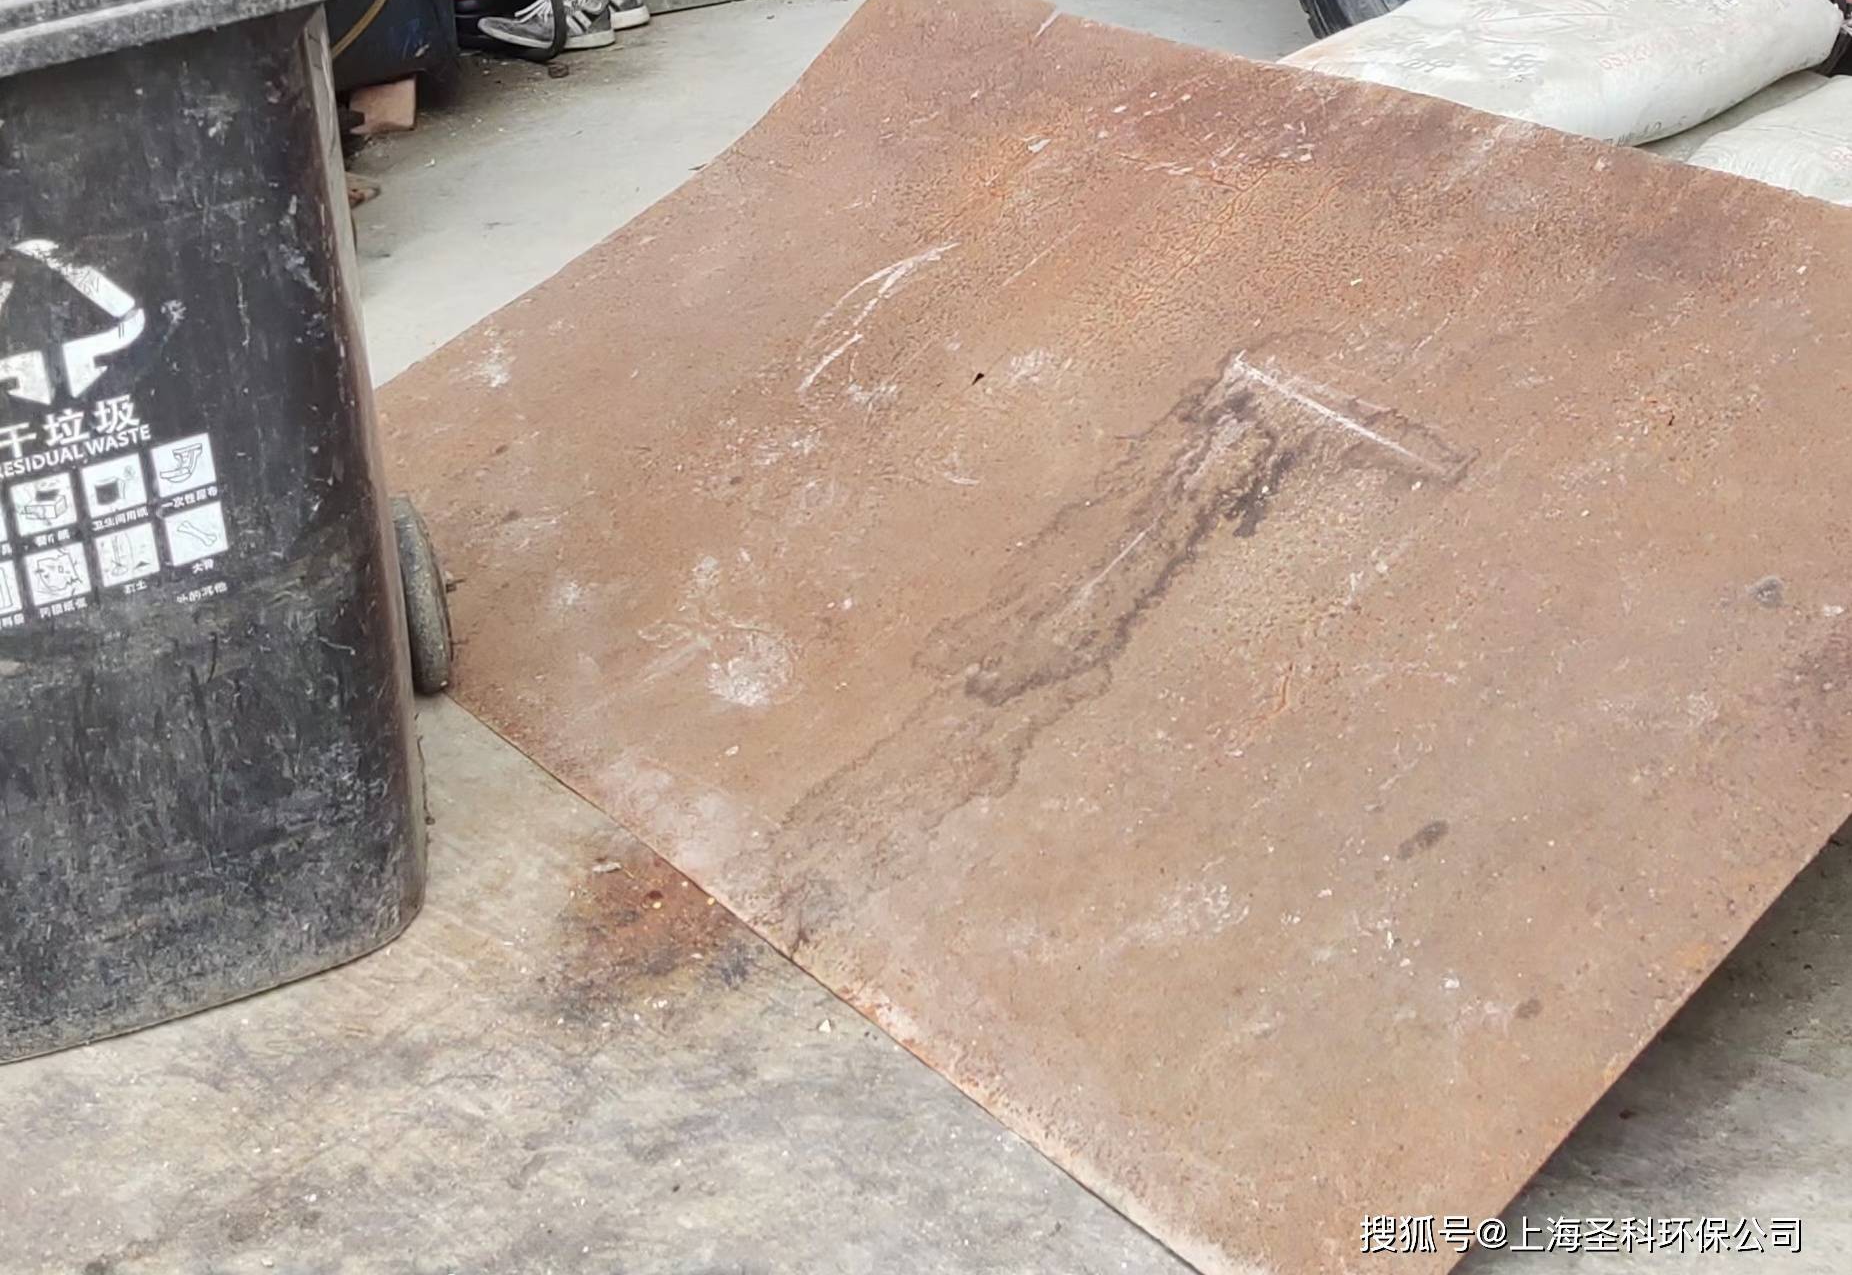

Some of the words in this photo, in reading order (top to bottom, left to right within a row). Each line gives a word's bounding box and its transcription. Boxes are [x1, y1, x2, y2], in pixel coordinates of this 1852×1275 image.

[0, 394, 140, 458] 干垃圾
[0, 443, 84, 478] ESIDUAL
[84, 424, 152, 456] WASTE
